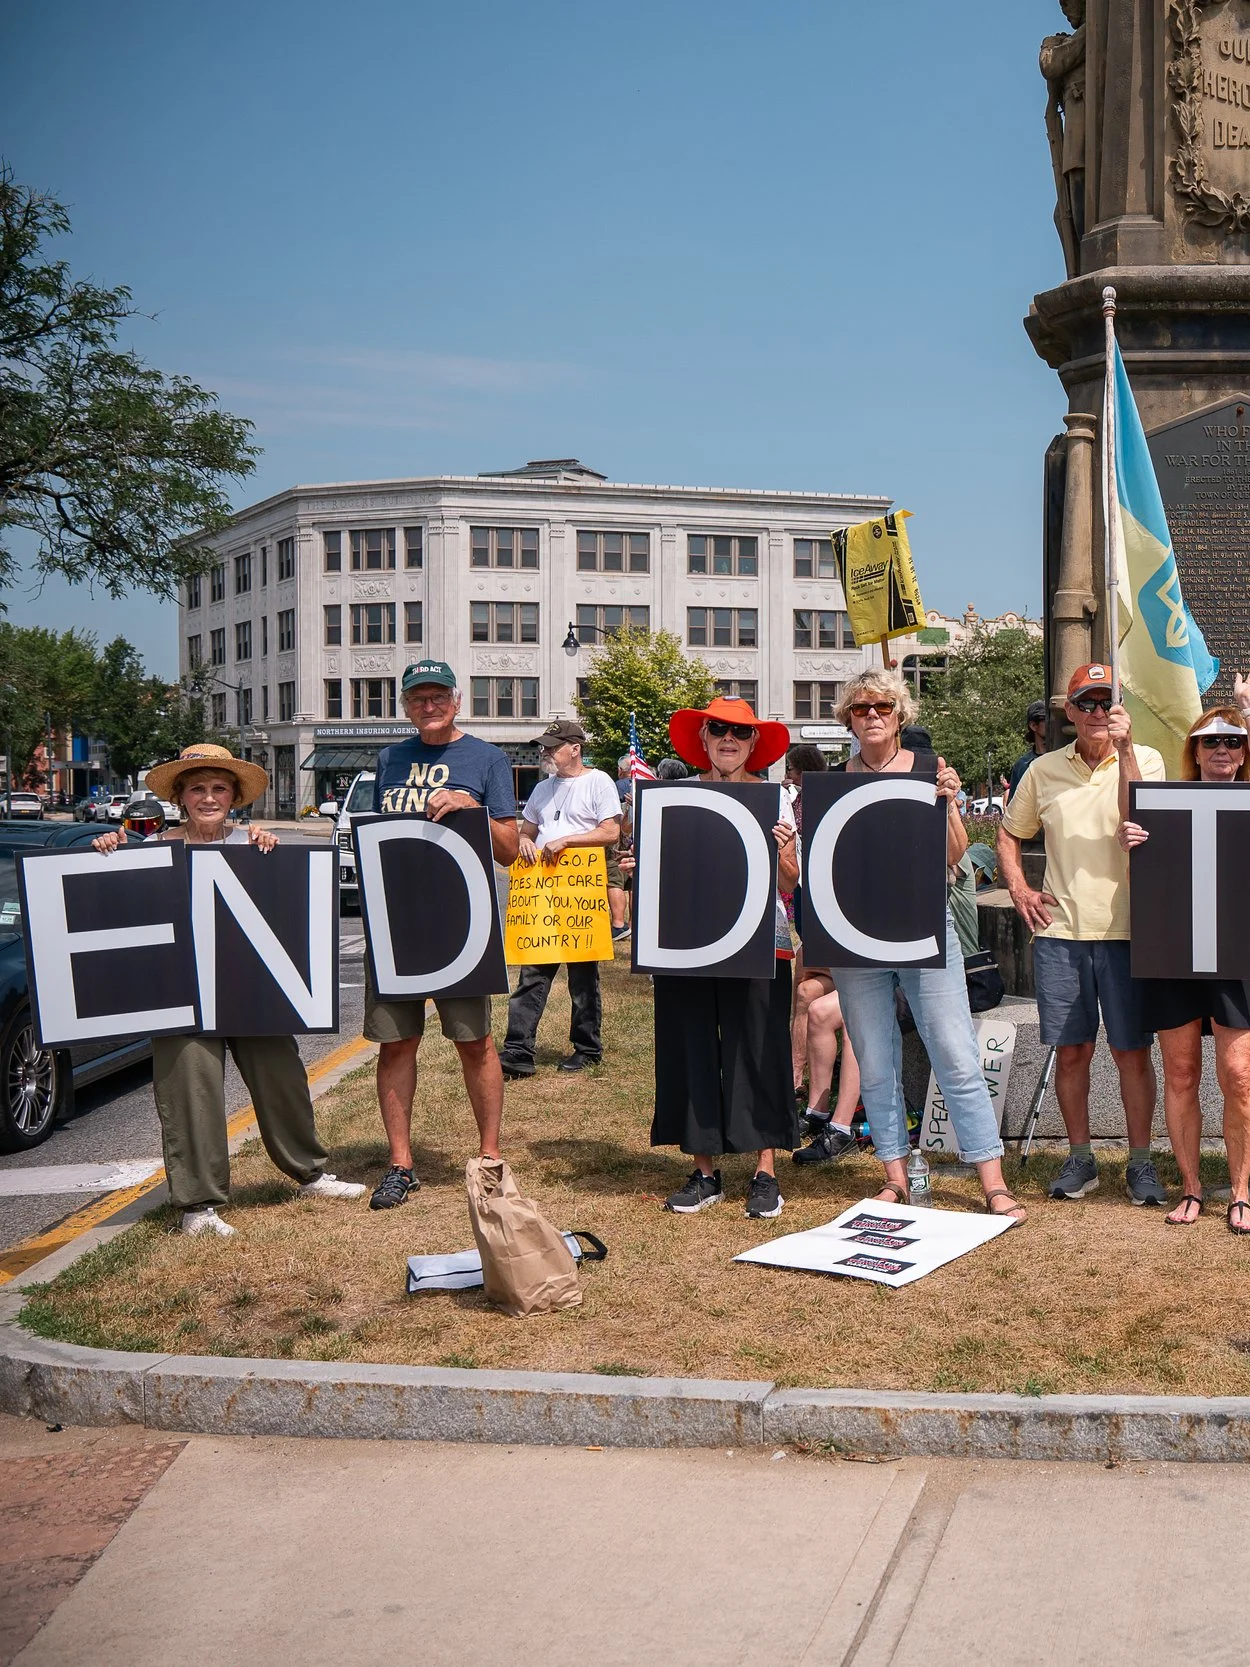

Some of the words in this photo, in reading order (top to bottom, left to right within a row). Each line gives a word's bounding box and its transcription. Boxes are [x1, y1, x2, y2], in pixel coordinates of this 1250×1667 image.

[1203, 425, 1239, 437] WHO
[1216, 440, 1232, 452] IN
[1165, 455, 1199, 467] WAR
[1201, 455, 1231, 467] FOR
[851, 560, 888, 577] IceAway
[412, 666, 429, 675] THIRD
[405, 763, 449, 787] NO
[381, 787, 470, 813] KIN
[535, 875, 563, 889] NOT
[567, 874, 603, 887] CARE
[574, 896, 607, 912] YOUR
[543, 914, 561, 927] OR
[566, 914, 593, 928] OUR
[516, 934, 581, 950] COUNTRY
